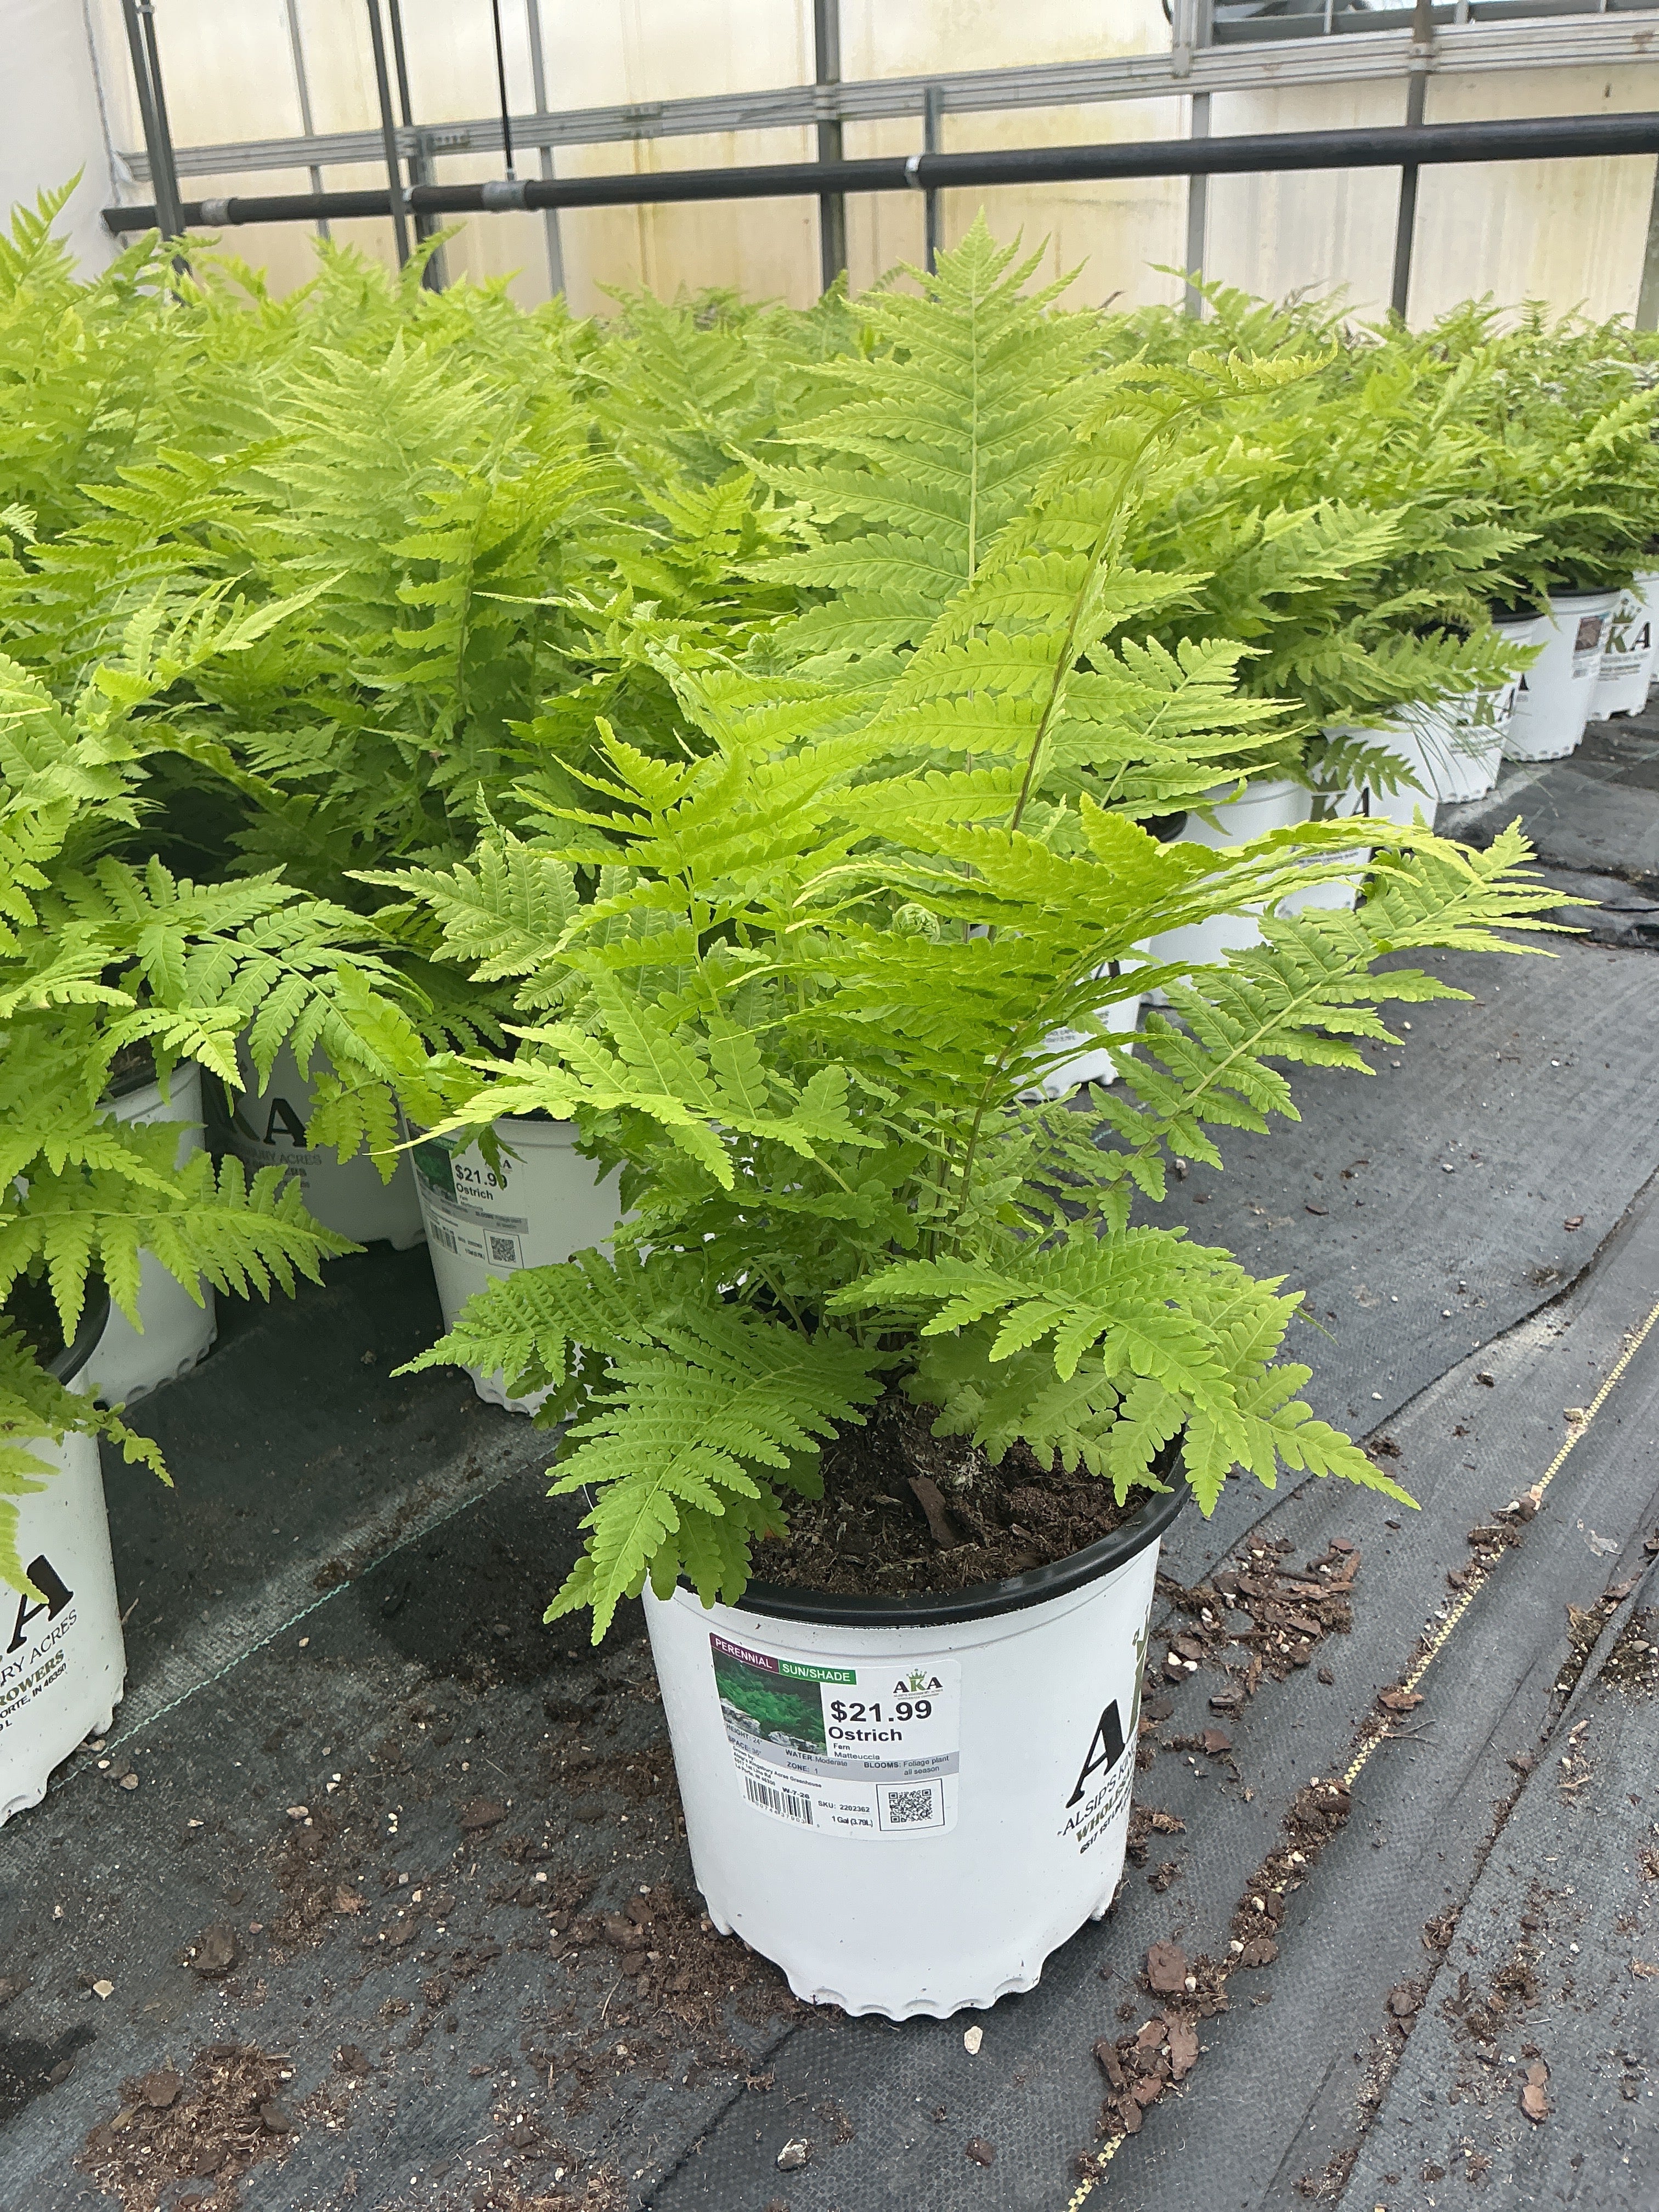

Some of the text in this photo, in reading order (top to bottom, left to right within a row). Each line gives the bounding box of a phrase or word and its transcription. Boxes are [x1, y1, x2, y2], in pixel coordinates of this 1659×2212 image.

[456, 1183, 494, 1200] Ostrich
[30, 1609, 77, 1664] ACRES
[715, 1637, 772, 1669] PERENNIAL
[32, 1684, 42, 1697] IN
[44, 1662, 66, 1688] 46350
[782, 1663, 851, 1682] SUN/SHADE
[893, 1676, 944, 1694] AKA
[831, 1700, 932, 1723] $21.99
[5, 1719, 13, 1728] L
[828, 1726, 902, 1742] Ostrich
[815, 1756, 848, 1767] Moderate
[834, 1751, 880, 1760] Matteuccia
[932, 1756, 949, 1765] plant
[787, 1761, 809, 1773] ZONE:
[913, 1766, 940, 1775] season
[818, 1800, 870, 1813] SKU: 2202362
[1062, 1774, 1117, 1836] ALSIP'S
